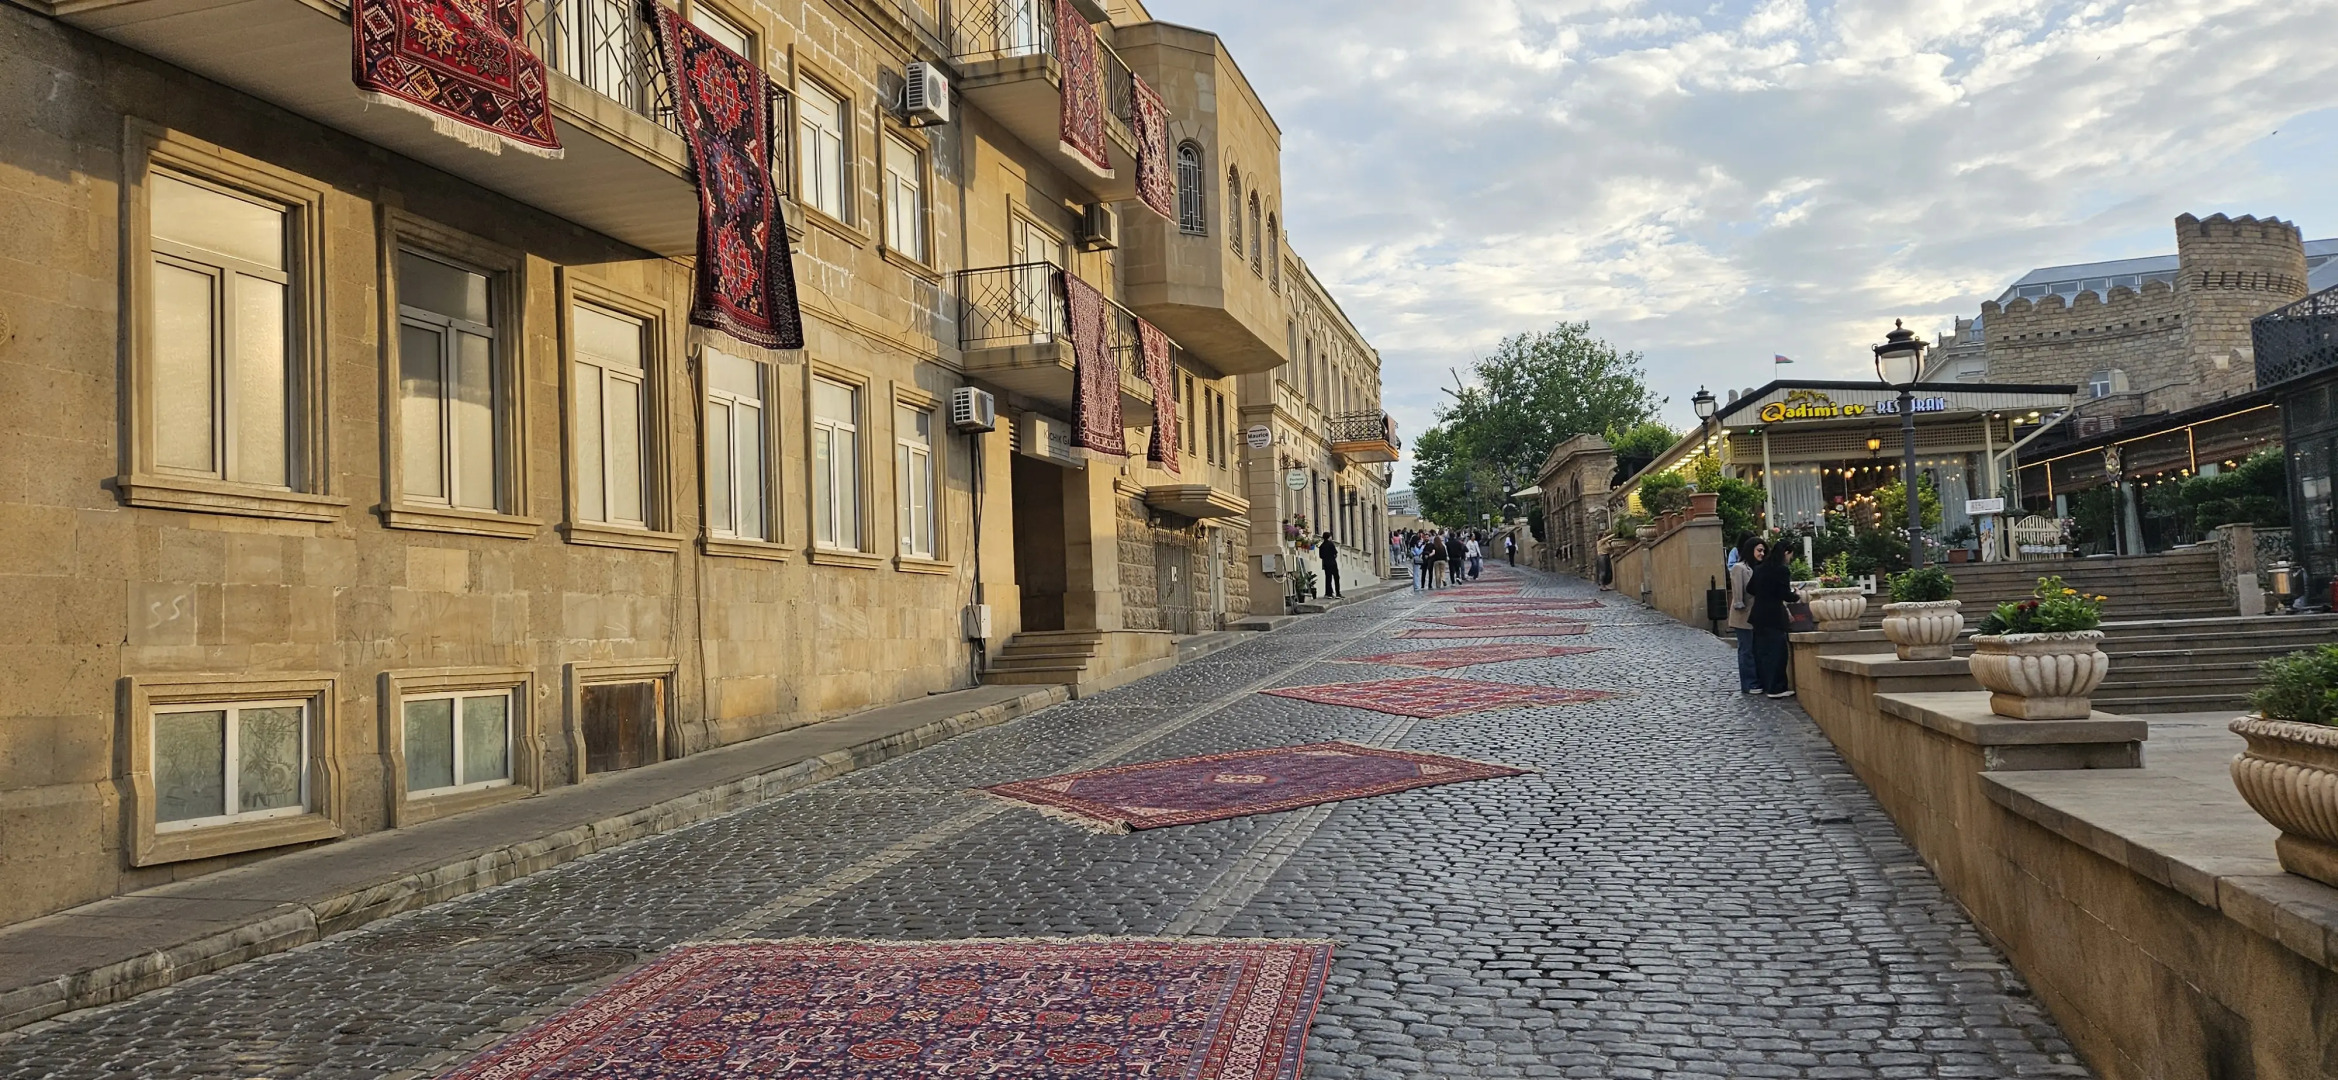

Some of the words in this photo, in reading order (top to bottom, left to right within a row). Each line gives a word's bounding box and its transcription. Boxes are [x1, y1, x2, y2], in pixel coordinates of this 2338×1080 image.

[1761, 401, 1838, 422] Qadimi
[1843, 404, 1865, 416] ev
[1876, 397, 1945, 414] RESRAN
